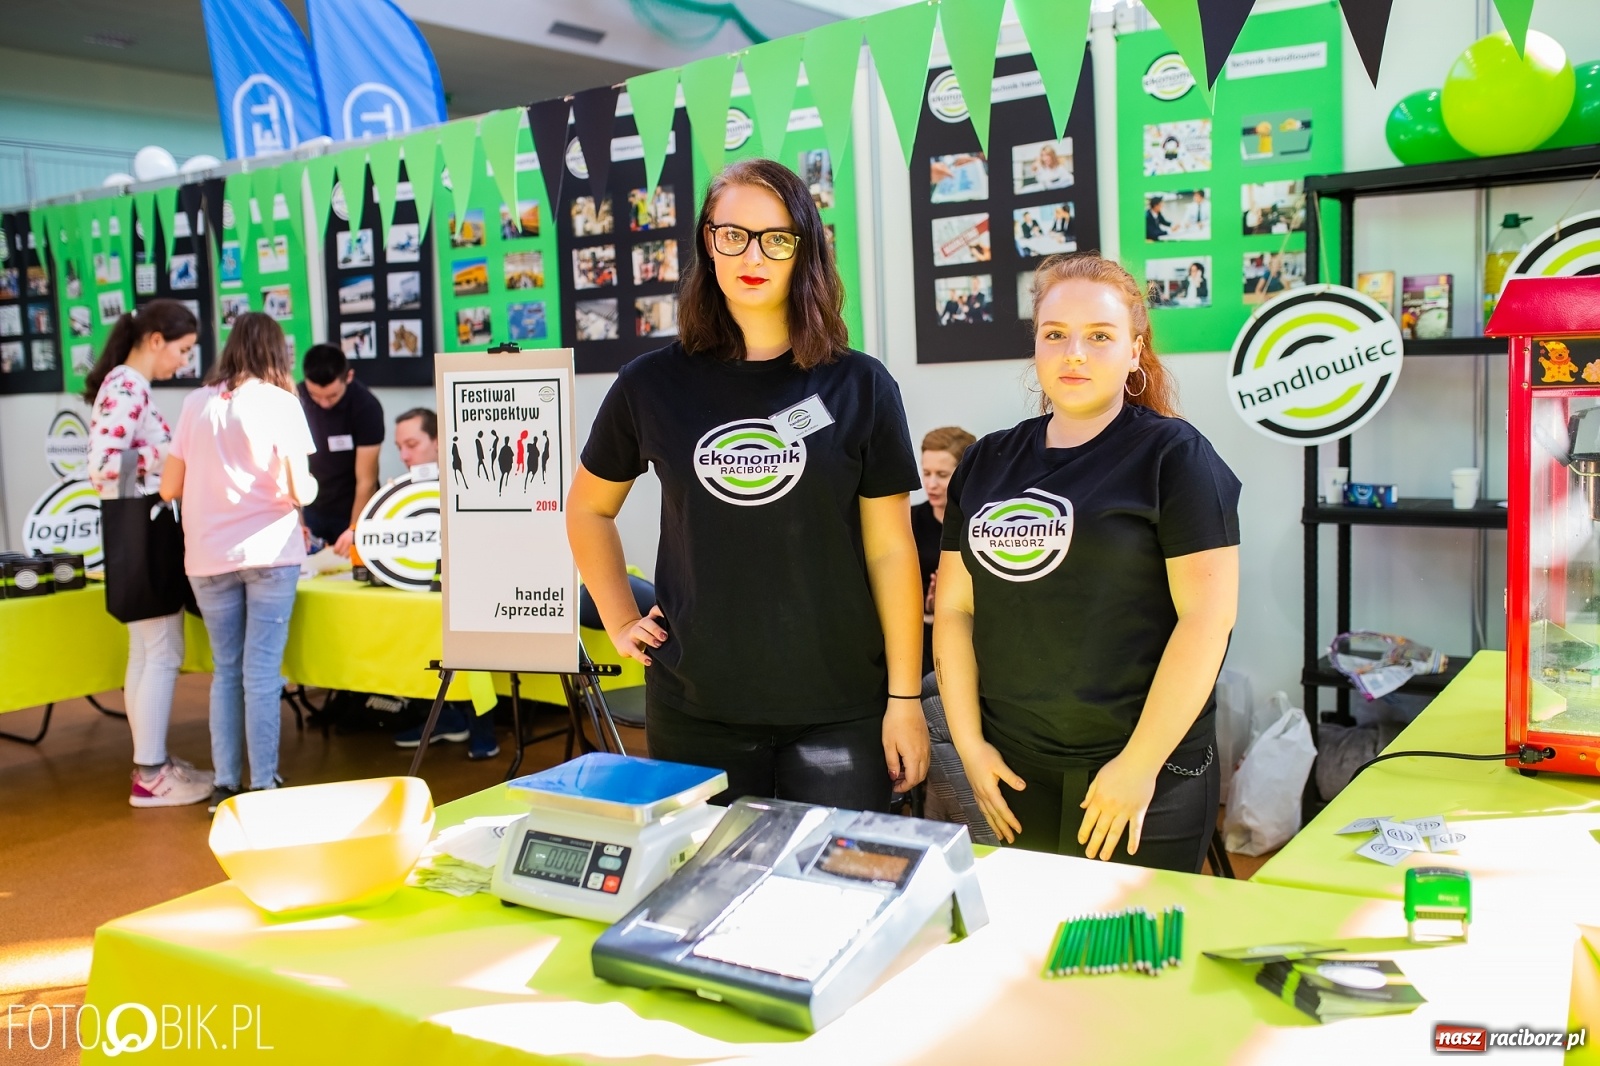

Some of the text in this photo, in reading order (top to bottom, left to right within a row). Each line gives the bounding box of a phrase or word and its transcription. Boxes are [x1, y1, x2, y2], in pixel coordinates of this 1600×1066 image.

[1237, 339, 1396, 410] handlowiec
[461, 387, 515, 403] Festiwal
[462, 405, 540, 423] perspektyw
[698, 449, 801, 466] ekonomik
[720, 465, 779, 475] RACIBÓRZ
[536, 500, 558, 512] 2019
[971, 519, 1068, 538] ekonomik
[989, 538, 1045, 548] RACIBÓRZ
[515, 586, 564, 601] handel
[494, 602, 565, 620] /sprzedaż
